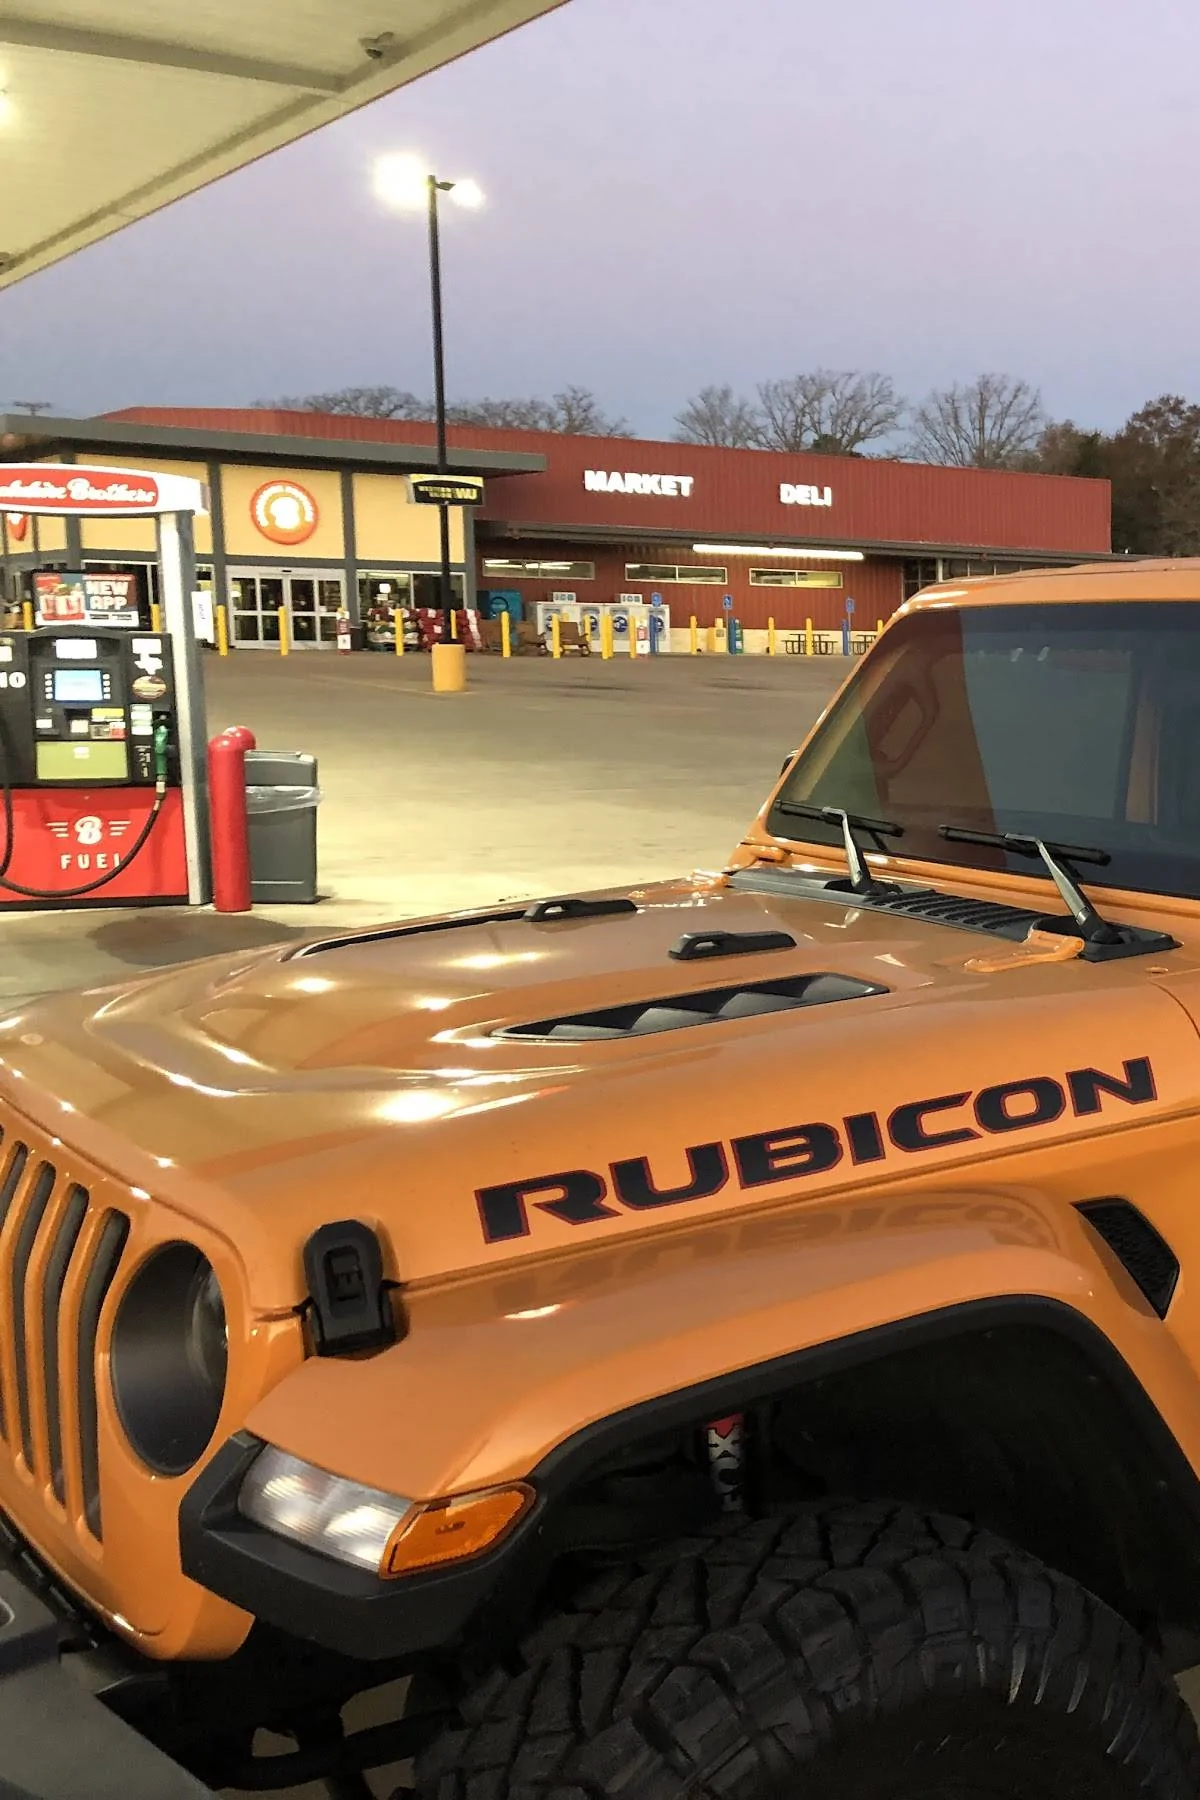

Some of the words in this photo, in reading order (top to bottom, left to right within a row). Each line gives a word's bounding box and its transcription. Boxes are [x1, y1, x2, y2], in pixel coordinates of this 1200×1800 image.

[583, 470, 694, 497] MARKET
[779, 483, 832, 506] DELI
[86, 580, 129, 596] NEW
[89, 595, 127, 610] APP
[474, 1055, 1159, 1245] RUBICON
